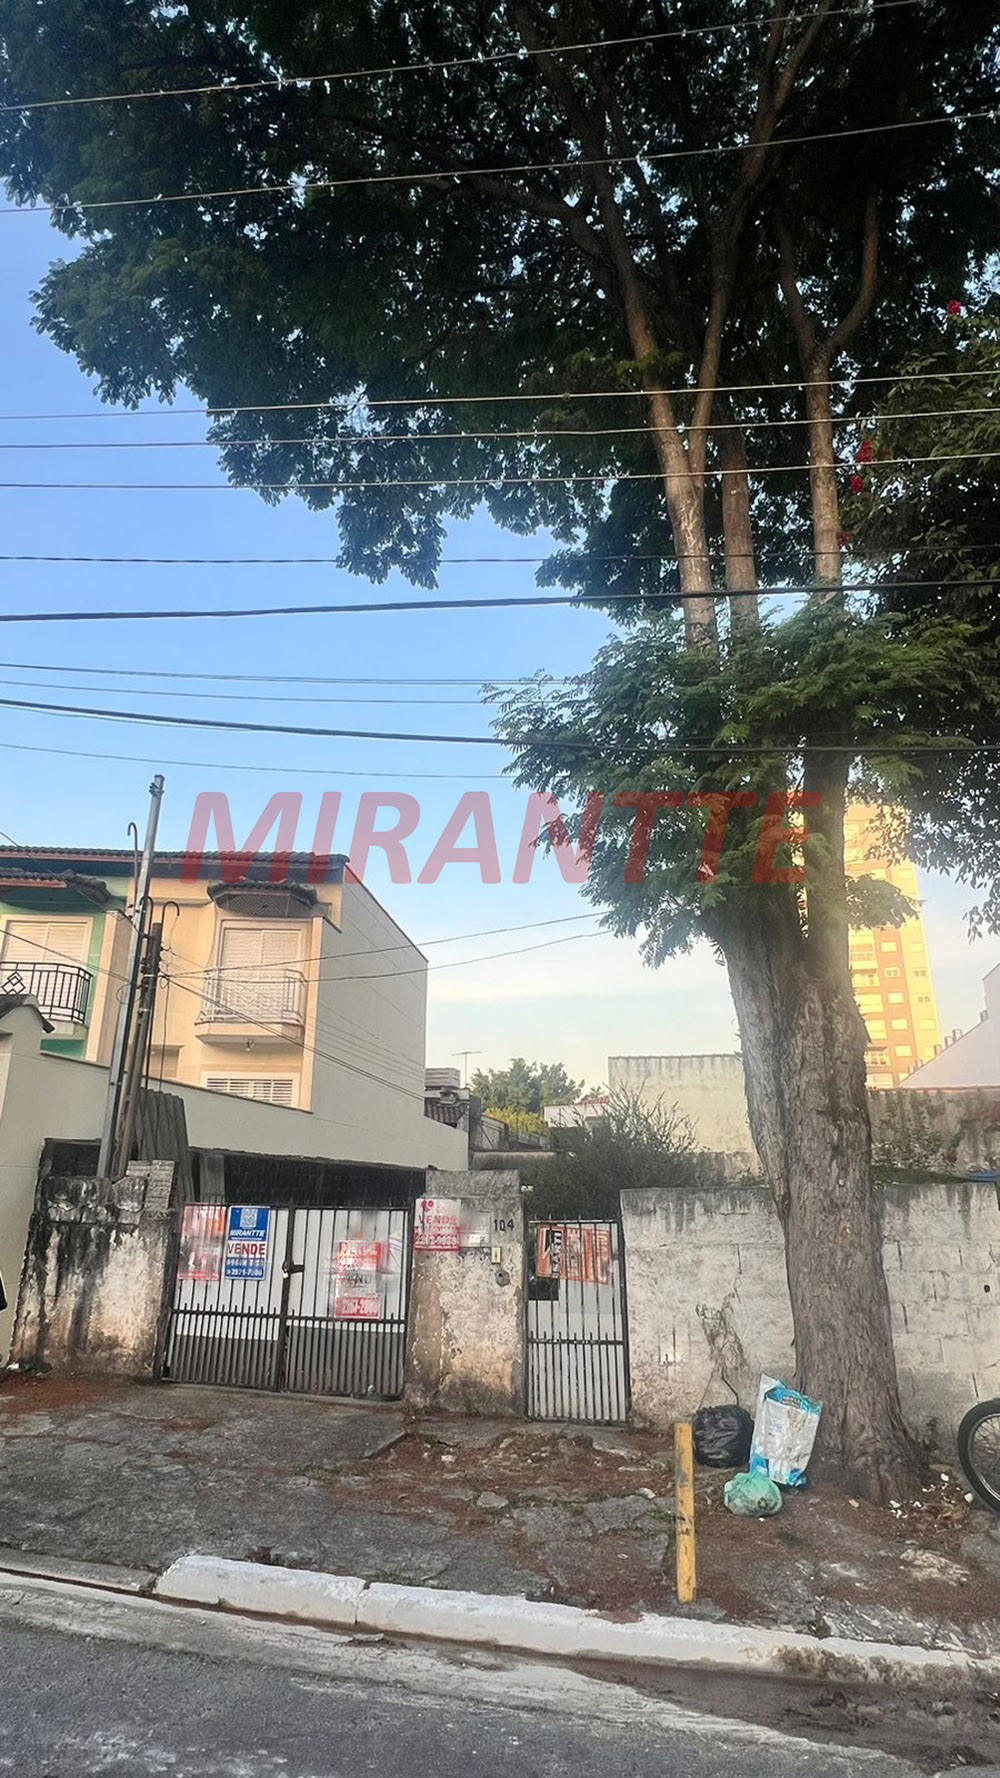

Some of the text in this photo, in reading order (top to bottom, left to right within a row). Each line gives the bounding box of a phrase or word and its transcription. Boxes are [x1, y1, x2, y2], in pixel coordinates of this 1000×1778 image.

[418, 1215, 459, 1226] VENDE
[494, 1218, 514, 1232] 104
[229, 1229, 266, 1237] MIRANTTE
[227, 1242, 266, 1256] VENDE
